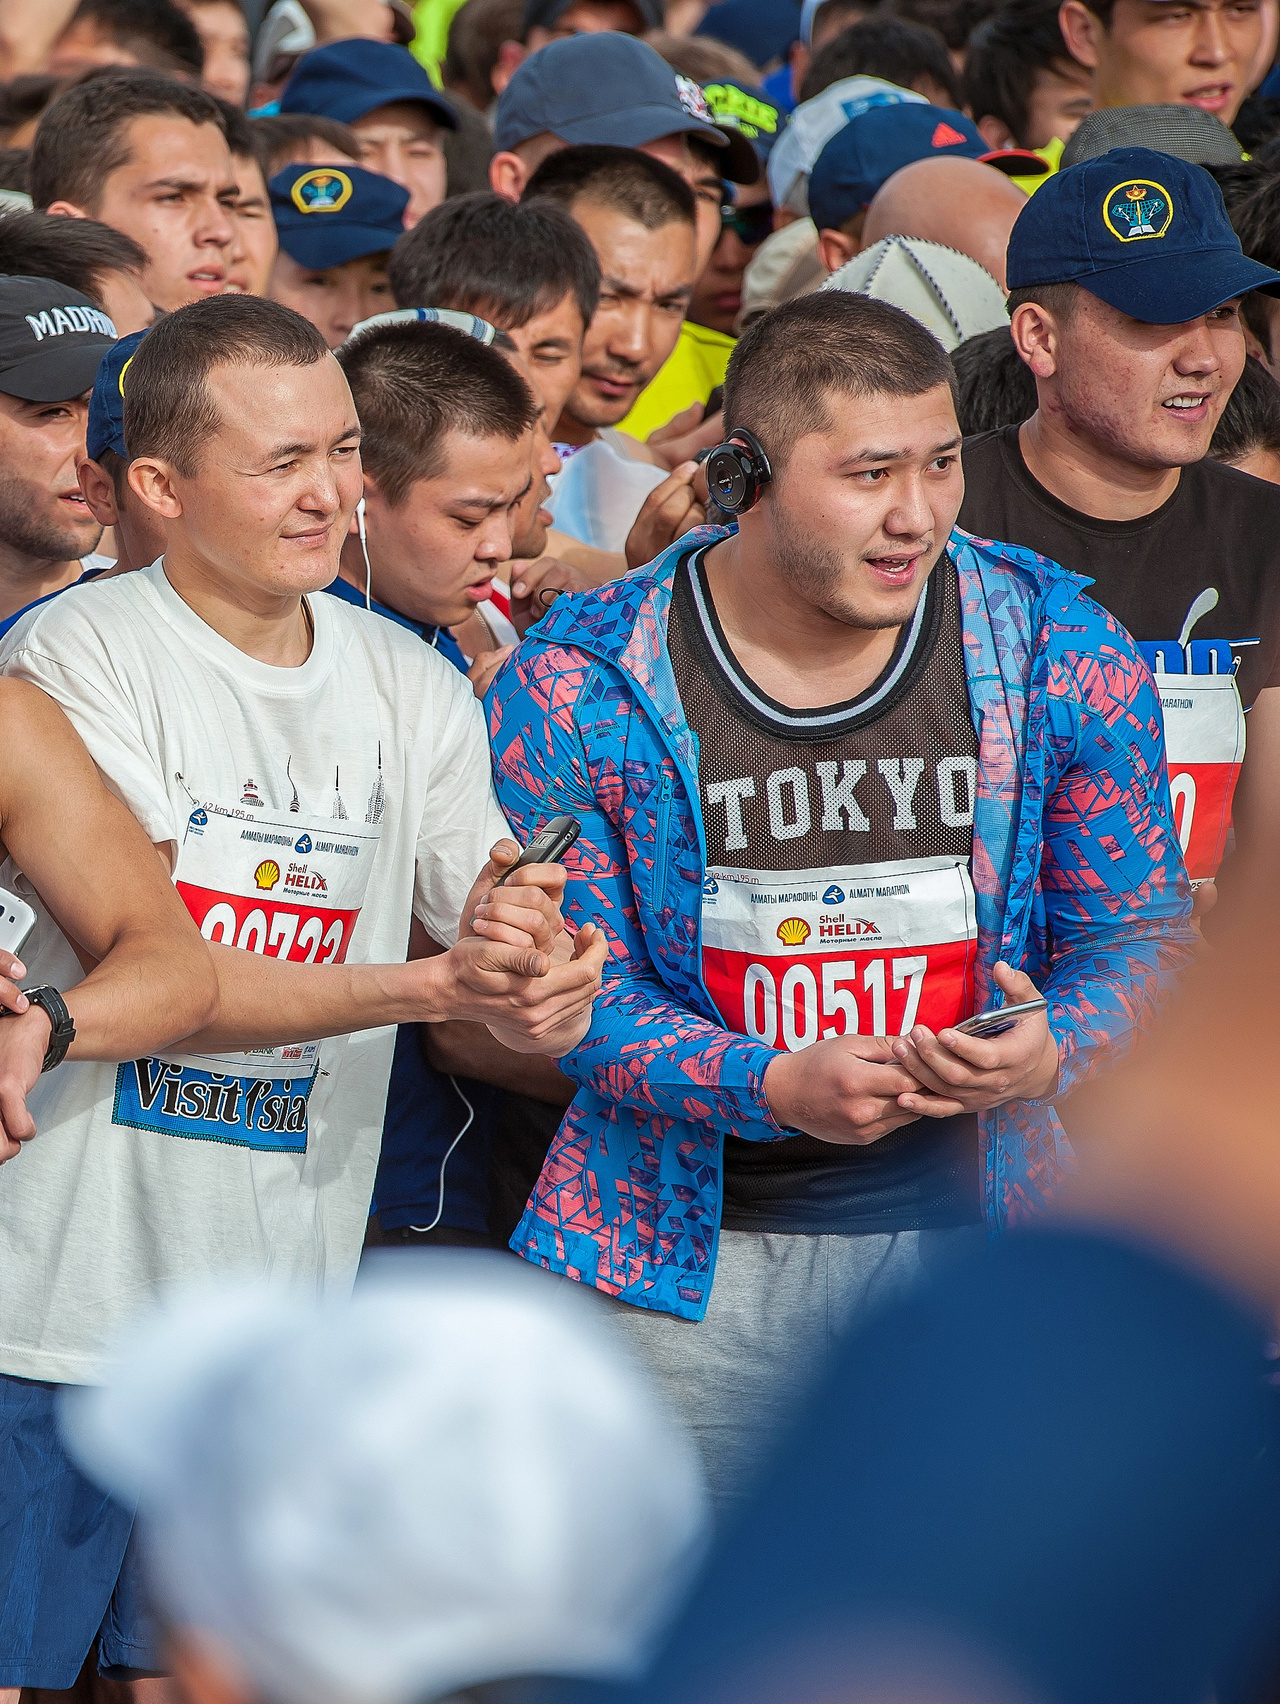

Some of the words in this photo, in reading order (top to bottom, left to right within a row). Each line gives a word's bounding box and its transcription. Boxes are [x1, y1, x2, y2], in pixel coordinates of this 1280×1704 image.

[203, 801, 214, 811] 42
[215, 804, 229, 815] km
[231, 809, 245, 818] 195
[706, 756, 979, 851] TOKYO
[288, 862, 308, 874] Shell
[285, 872, 327, 891] HELIX
[737, 873, 750, 882] 195
[750, 892, 777, 904] АЛМАТЫ
[778, 890, 818, 904] МАРАФОНЫ
[849, 887, 875, 899] ALMATY
[875, 884, 910, 897] MARATHON
[819, 914, 845, 924] Shell
[819, 920, 881, 937] HELIX
[743, 955, 928, 1053] 00517
[133, 1058, 243, 1124] Visit
